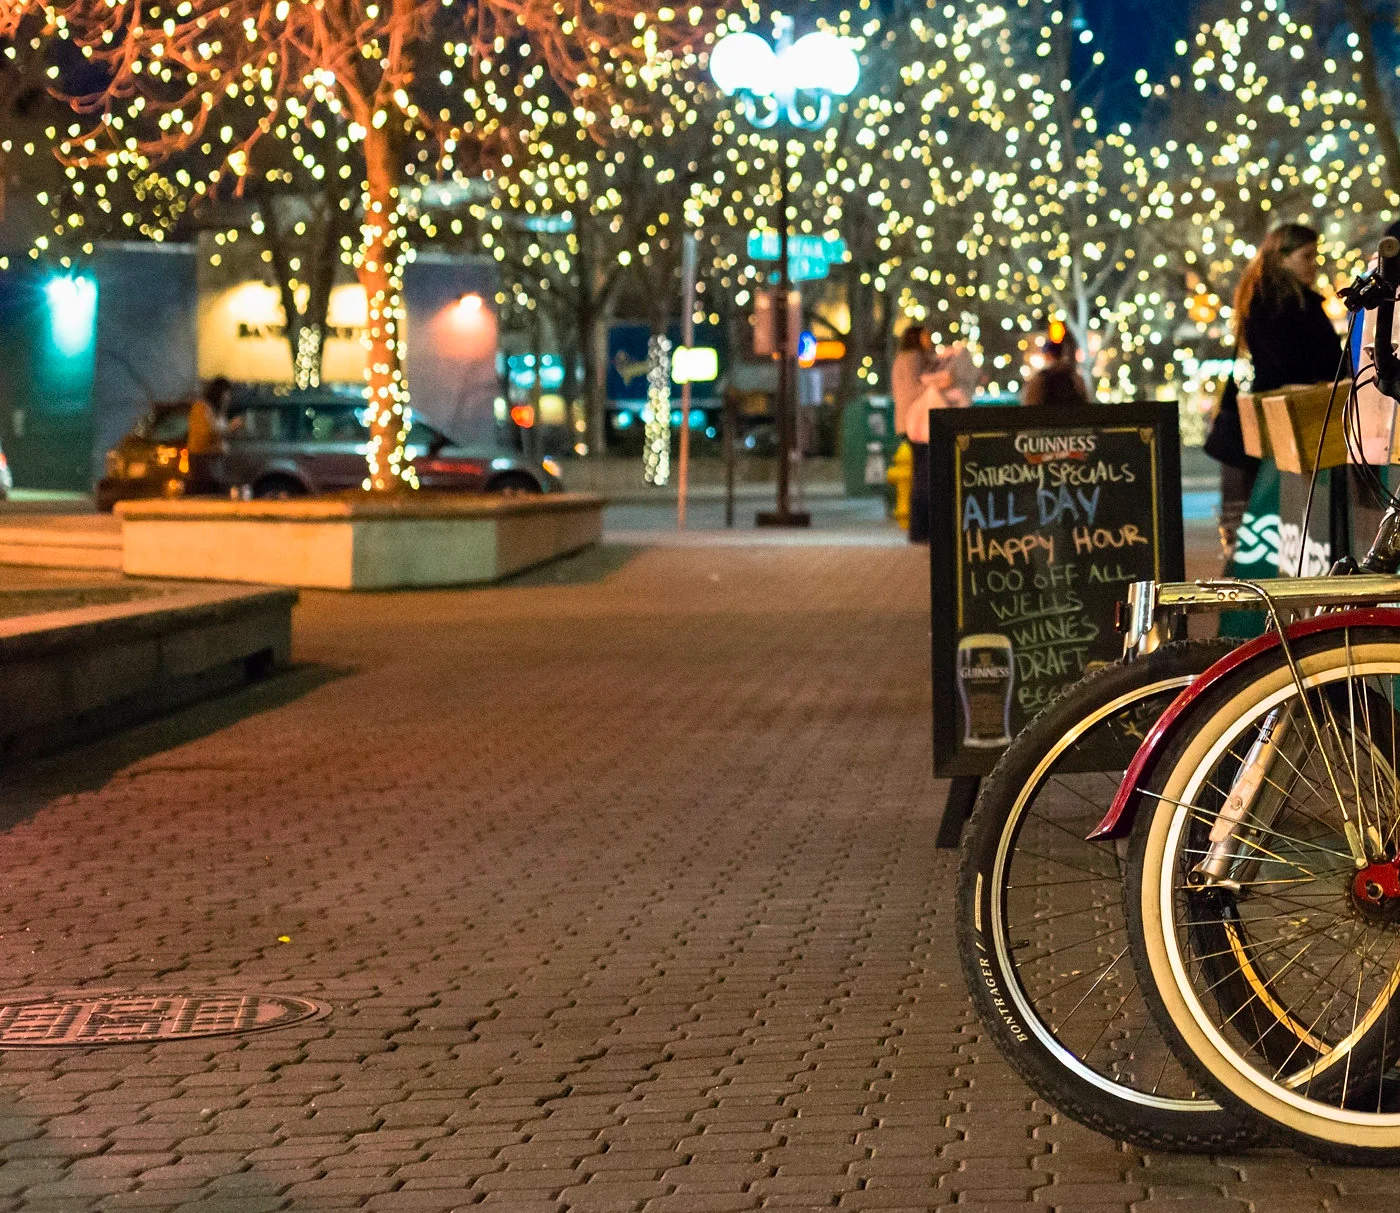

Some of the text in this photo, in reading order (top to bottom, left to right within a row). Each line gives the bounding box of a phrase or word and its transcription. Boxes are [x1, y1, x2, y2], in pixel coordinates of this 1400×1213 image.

[1014, 434, 1096, 453] GUINNESS
[963, 461, 1136, 489] SATURDAY SPECIALS
[963, 484, 1100, 531] ALL DAY
[966, 524, 1149, 567] HAPPY HOUR
[1089, 563, 1137, 583] ALL
[990, 591, 1084, 621] WELLS
[1013, 615, 1099, 645] WINES
[959, 667, 1008, 679] GUINNESS
[1014, 647, 1089, 682] DRAFT
[980, 958, 1028, 1042] BONTRAGER
